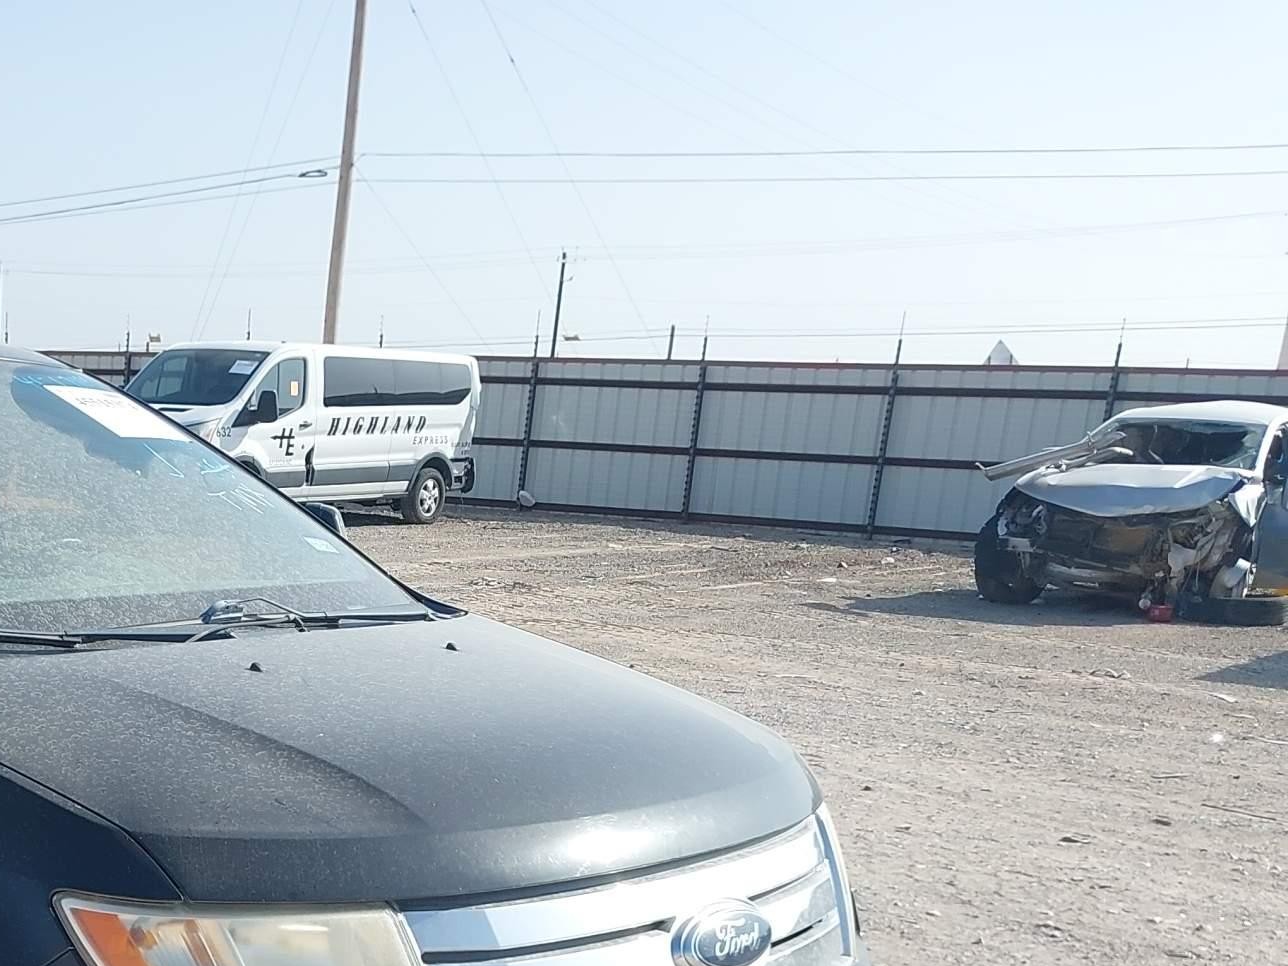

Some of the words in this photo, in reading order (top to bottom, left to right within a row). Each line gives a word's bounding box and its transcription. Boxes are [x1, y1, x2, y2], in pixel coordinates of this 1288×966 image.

[327, 415, 427, 436] HIGHLAND
[412, 435, 449, 446] EXPRESS
[715, 917, 761, 959] Ford
